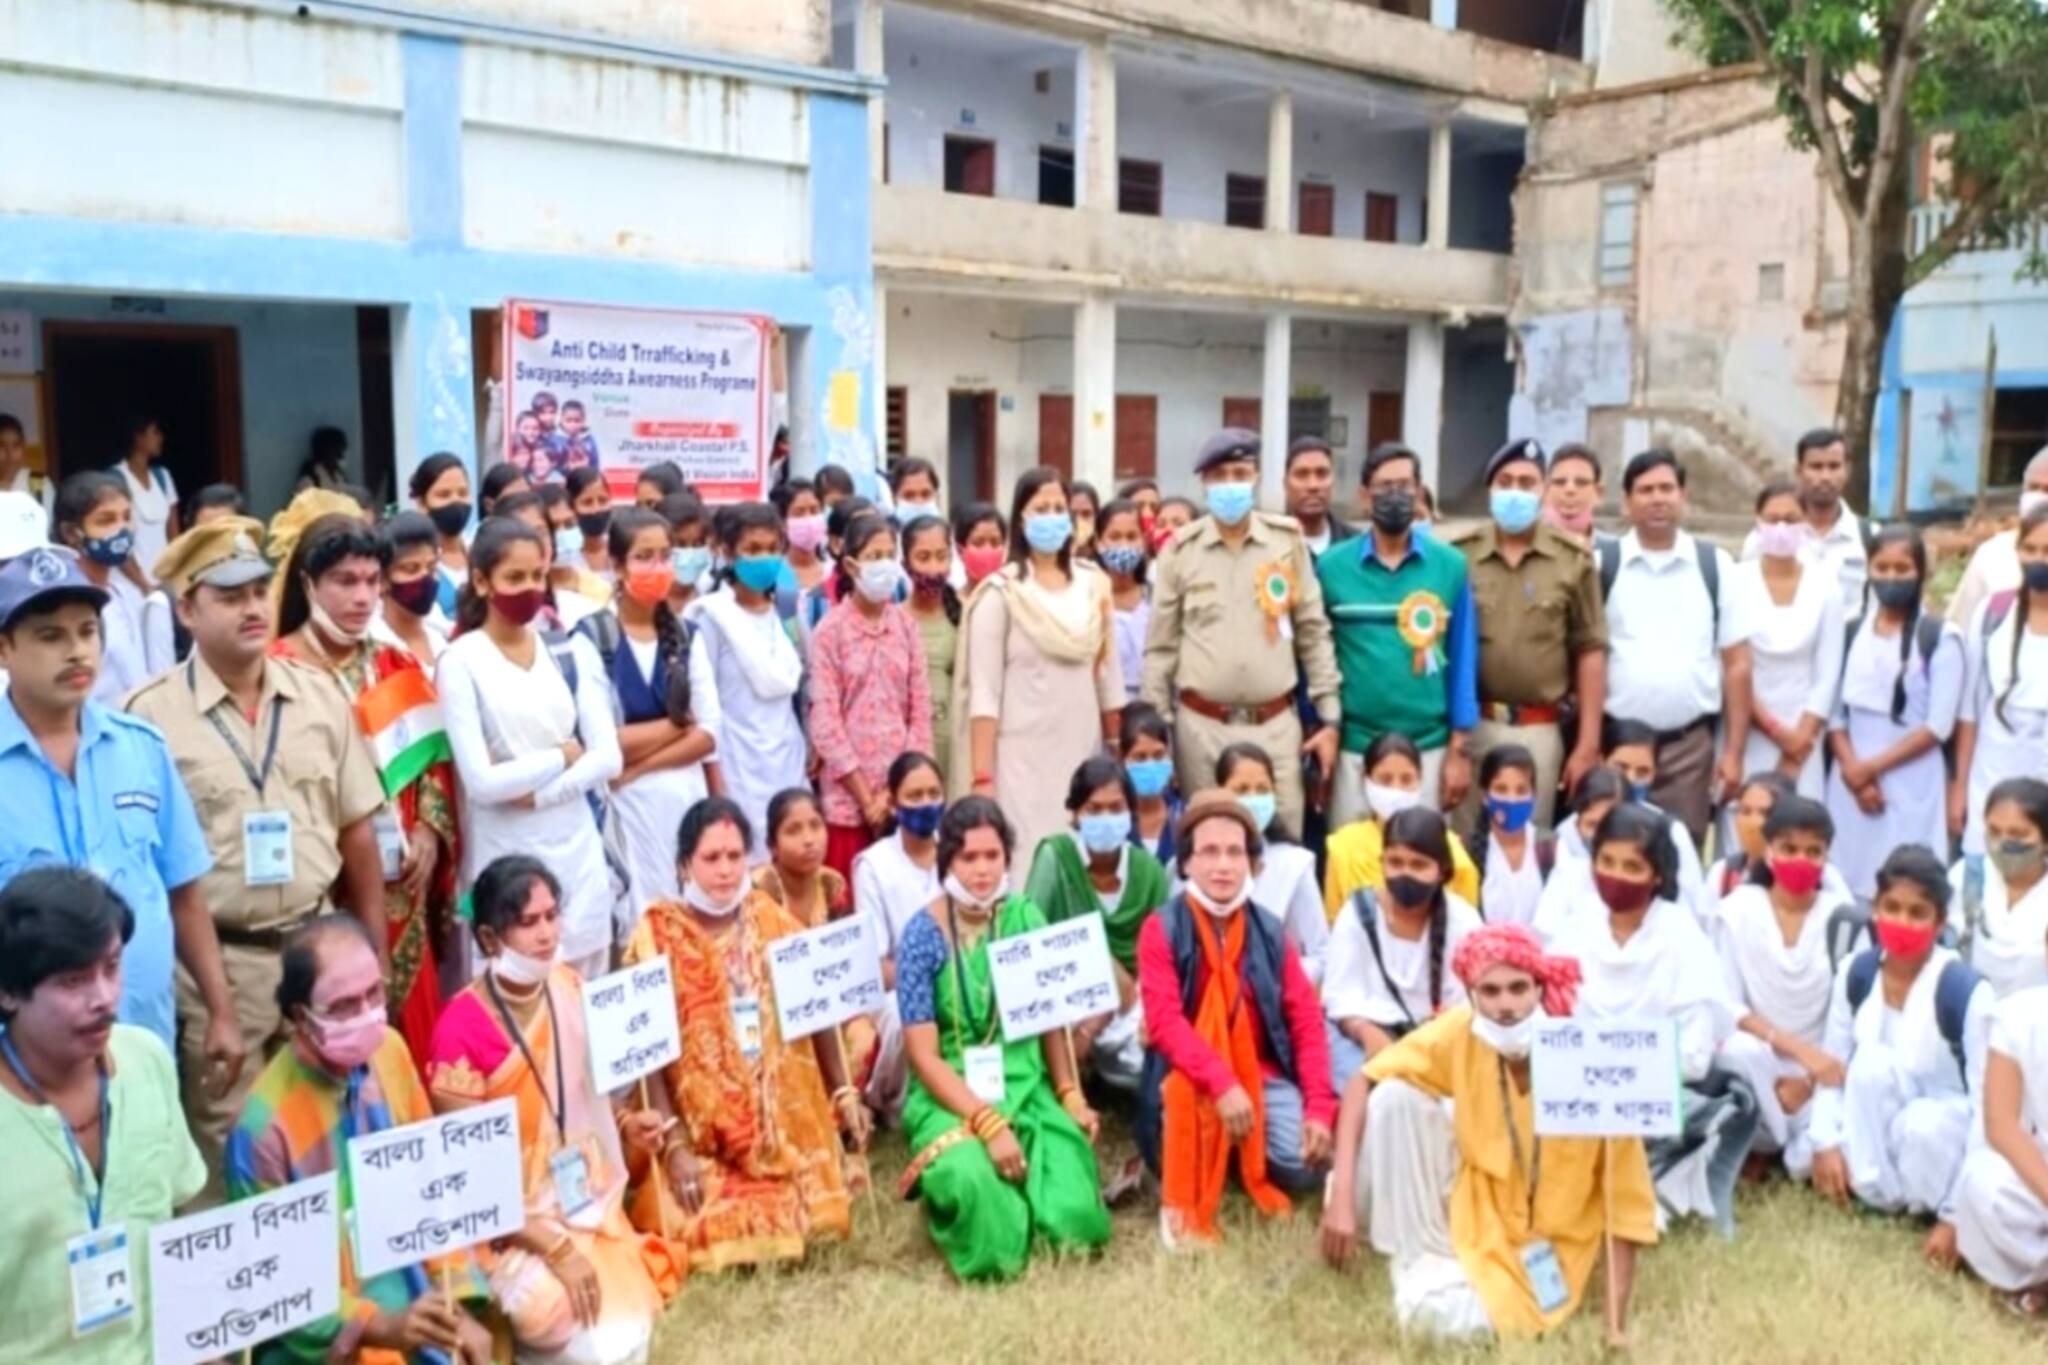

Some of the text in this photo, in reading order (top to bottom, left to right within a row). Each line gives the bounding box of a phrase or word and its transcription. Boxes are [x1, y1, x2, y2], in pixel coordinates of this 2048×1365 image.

[551, 340, 731, 369] Anti Child Trrafficking &
[516, 362, 756, 393] Swayangsiddha Awearness Programe
[618, 440, 677, 452] Jharkhali
[680, 440, 727, 452] Coastal
[1598, 1030, 1658, 1048] পাচার
[1584, 1065, 1637, 1086] থেকে
[1614, 1101, 1673, 1127] থাকুন
[362, 1111, 514, 1169] বাল্য বিবাহ
[419, 1170, 468, 1201] এক
[160, 1222, 234, 1261] বাল্য
[251, 1188, 332, 1239] বিবাহ
[386, 1203, 500, 1254] অভিশাপ
[225, 1255, 281, 1291] এক
[184, 1286, 314, 1350] অভিশাপ
